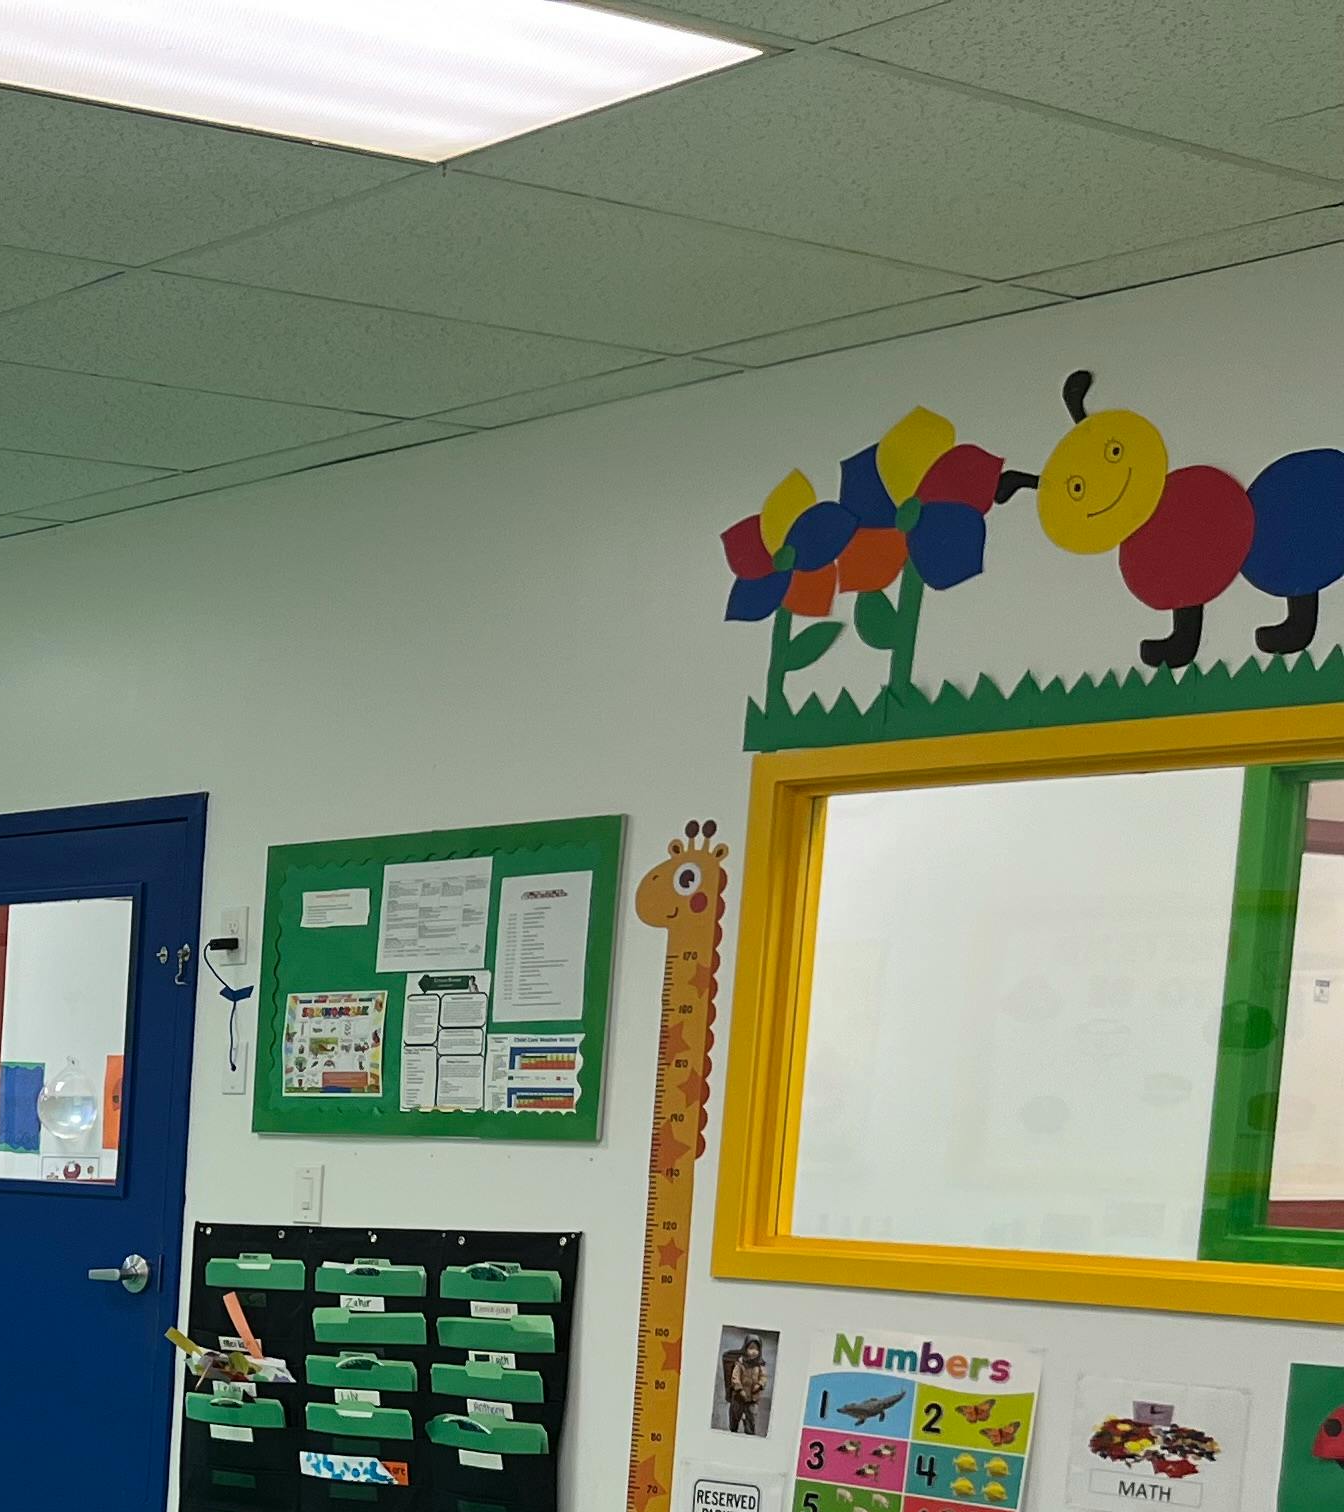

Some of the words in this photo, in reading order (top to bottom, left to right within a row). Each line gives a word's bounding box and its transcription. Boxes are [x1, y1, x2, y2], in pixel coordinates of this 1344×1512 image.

[683, 951, 698, 961] 170
[662, 1222, 677, 1231] 120
[655, 1328, 669, 1338] 100
[833, 1332, 1011, 1383] Numbers
[819, 1389, 829, 1419] 1
[922, 1403, 944, 1434] 2
[650, 1432, 661, 1441] 80
[806, 1441, 825, 1471] 3
[915, 1455, 937, 1487] 4
[646, 1485, 658, 1494] 70
[696, 1489, 756, 1510] RESERVED
[1118, 1479, 1172, 1502] MATH
